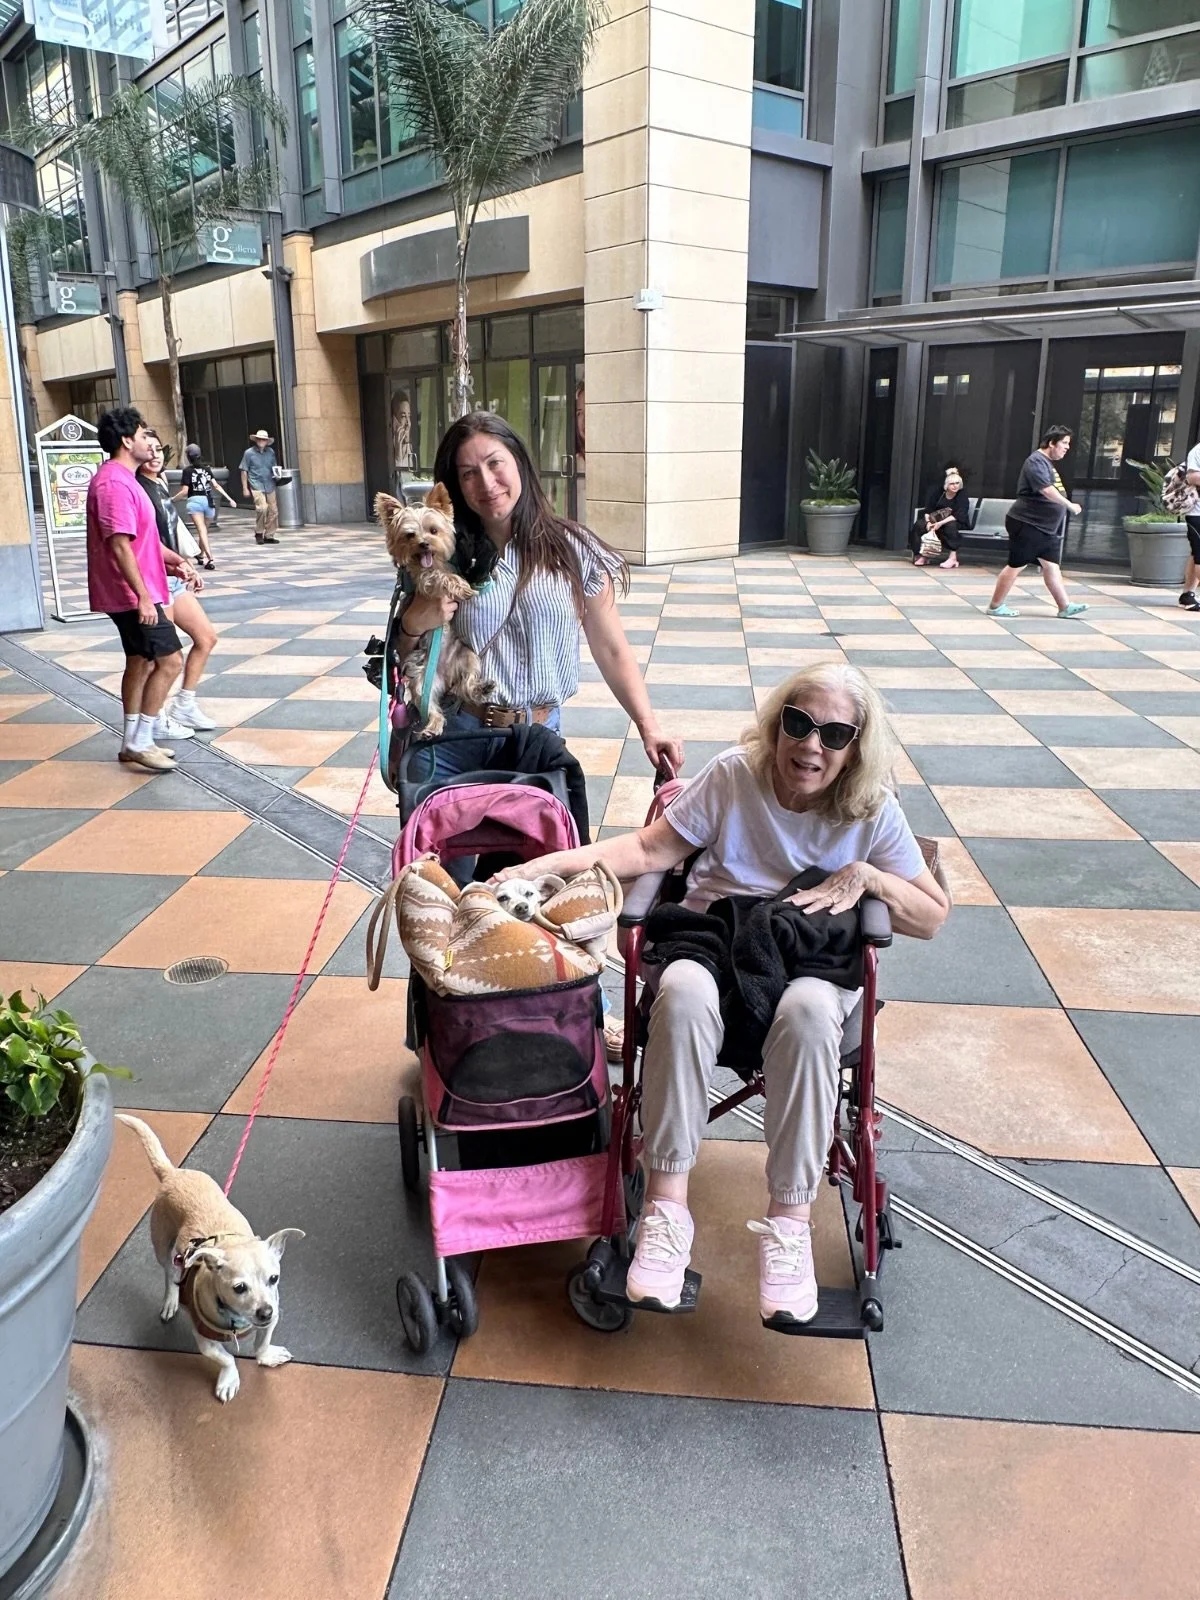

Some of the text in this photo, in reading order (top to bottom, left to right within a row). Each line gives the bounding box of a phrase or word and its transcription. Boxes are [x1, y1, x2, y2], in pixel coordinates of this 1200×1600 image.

[212, 226, 234, 262] g
[60, 286, 77, 313] g
[447, 375, 475, 397] FR
